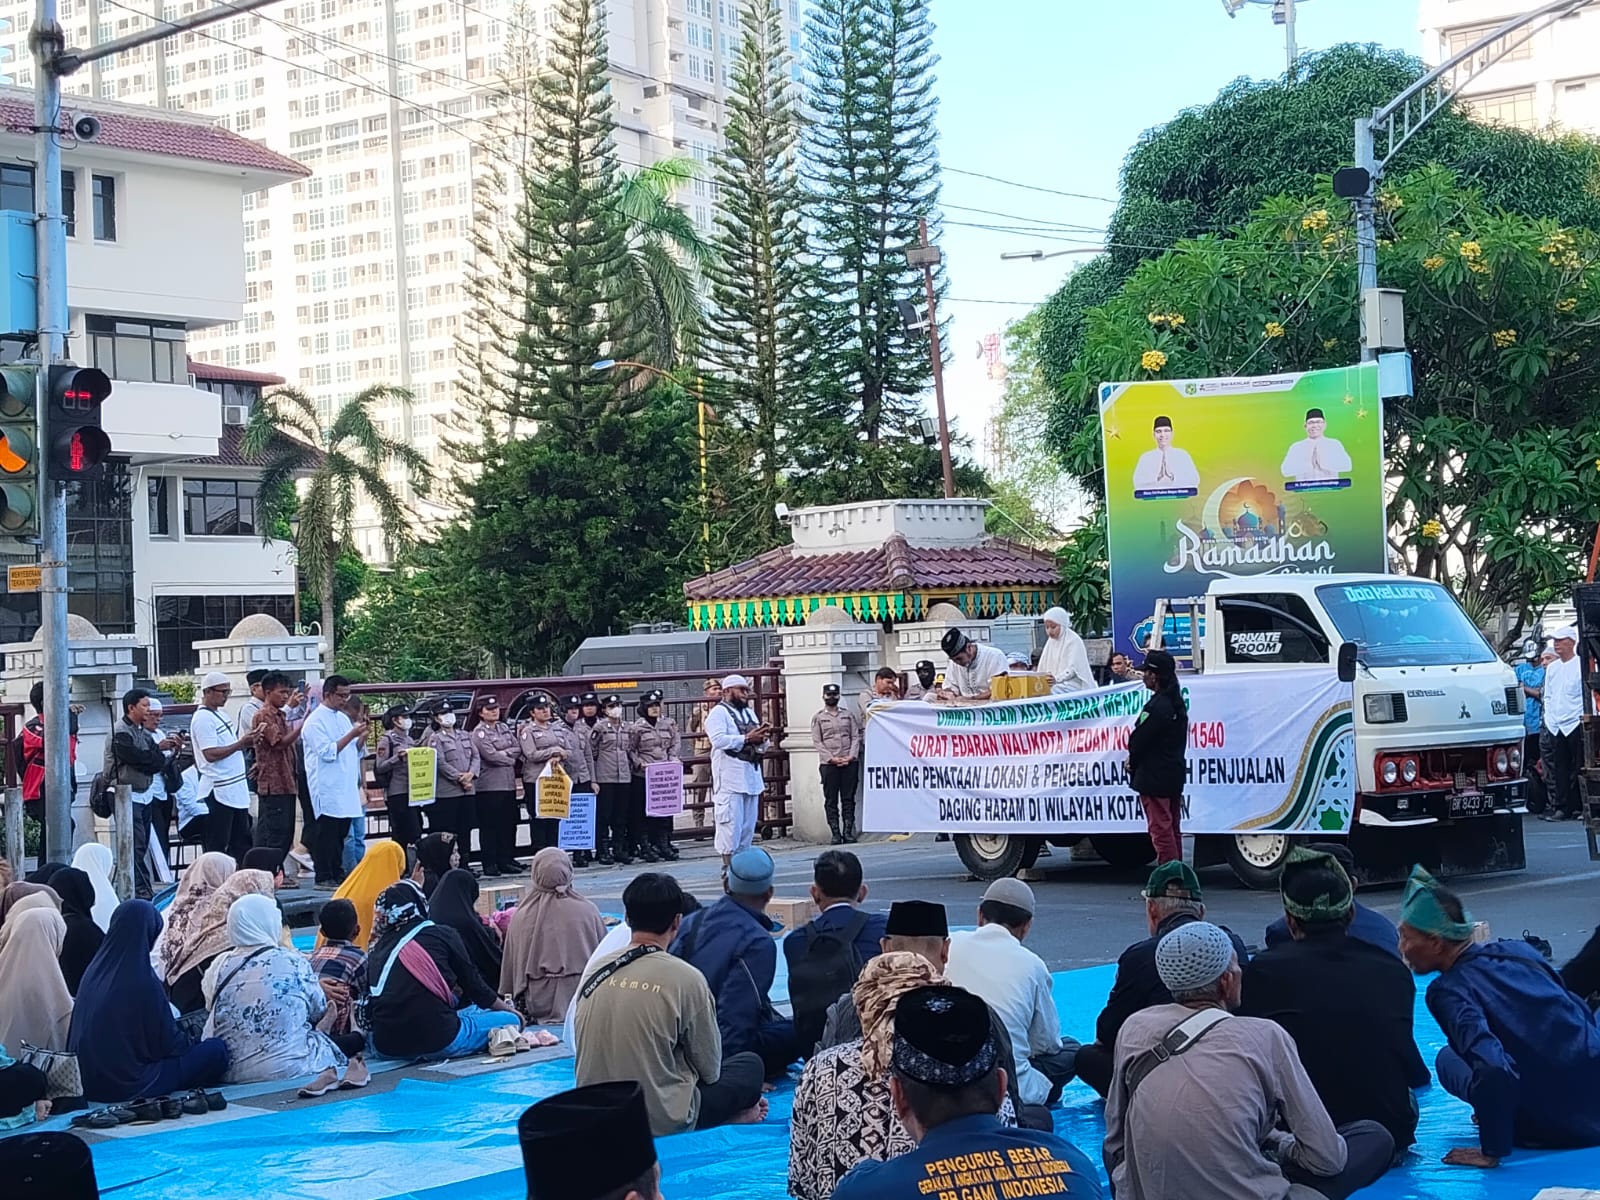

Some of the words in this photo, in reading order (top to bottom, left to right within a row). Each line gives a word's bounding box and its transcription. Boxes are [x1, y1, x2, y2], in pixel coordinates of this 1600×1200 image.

[1163, 518, 1336, 574] Ramadhan
[11, 570, 42, 578] MENYEBERAN
[1230, 632, 1281, 643] PRIVATE
[1237, 643, 1278, 654] ROOM
[936, 709, 977, 727] UMMAT
[981, 706, 1017, 726] ISLAM
[1020, 702, 1053, 724] KOTA
[1054, 695, 1100, 721] MEDAN
[910, 735, 947, 758] SURAT
[951, 733, 998, 757] EDARAN
[1000, 729, 1063, 756] WALIKOTA
[1067, 727, 1110, 753] MEDAN
[868, 766, 919, 789] TENTANG
[922, 765, 982, 789] PENATAAN
[984, 764, 1029, 789] LOKASI
[1031, 764, 1039, 788] &
[1044, 760, 1129, 788] PENGELOLAA
[1199, 757, 1286, 785] PENJUALAN
[939, 798, 981, 822] DAGING
[984, 798, 1026, 822] HARAM
[1029, 797, 1041, 821] DI
[1044, 795, 1103, 822] WILAYAH
[1107, 795, 1145, 820] KOTA
[584, 969, 611, 995] supreme
[602, 976, 661, 993] kémon
[925, 1151, 1004, 1177] PENGURUS
[1007, 1147, 1054, 1164] BESAR
[918, 1174, 954, 1195] GERAKAN
[955, 1168, 993, 1188] ANGKATAN
[1013, 1163, 1042, 1178] MELAYU
[1001, 1176, 1068, 1200] INDONESIA
